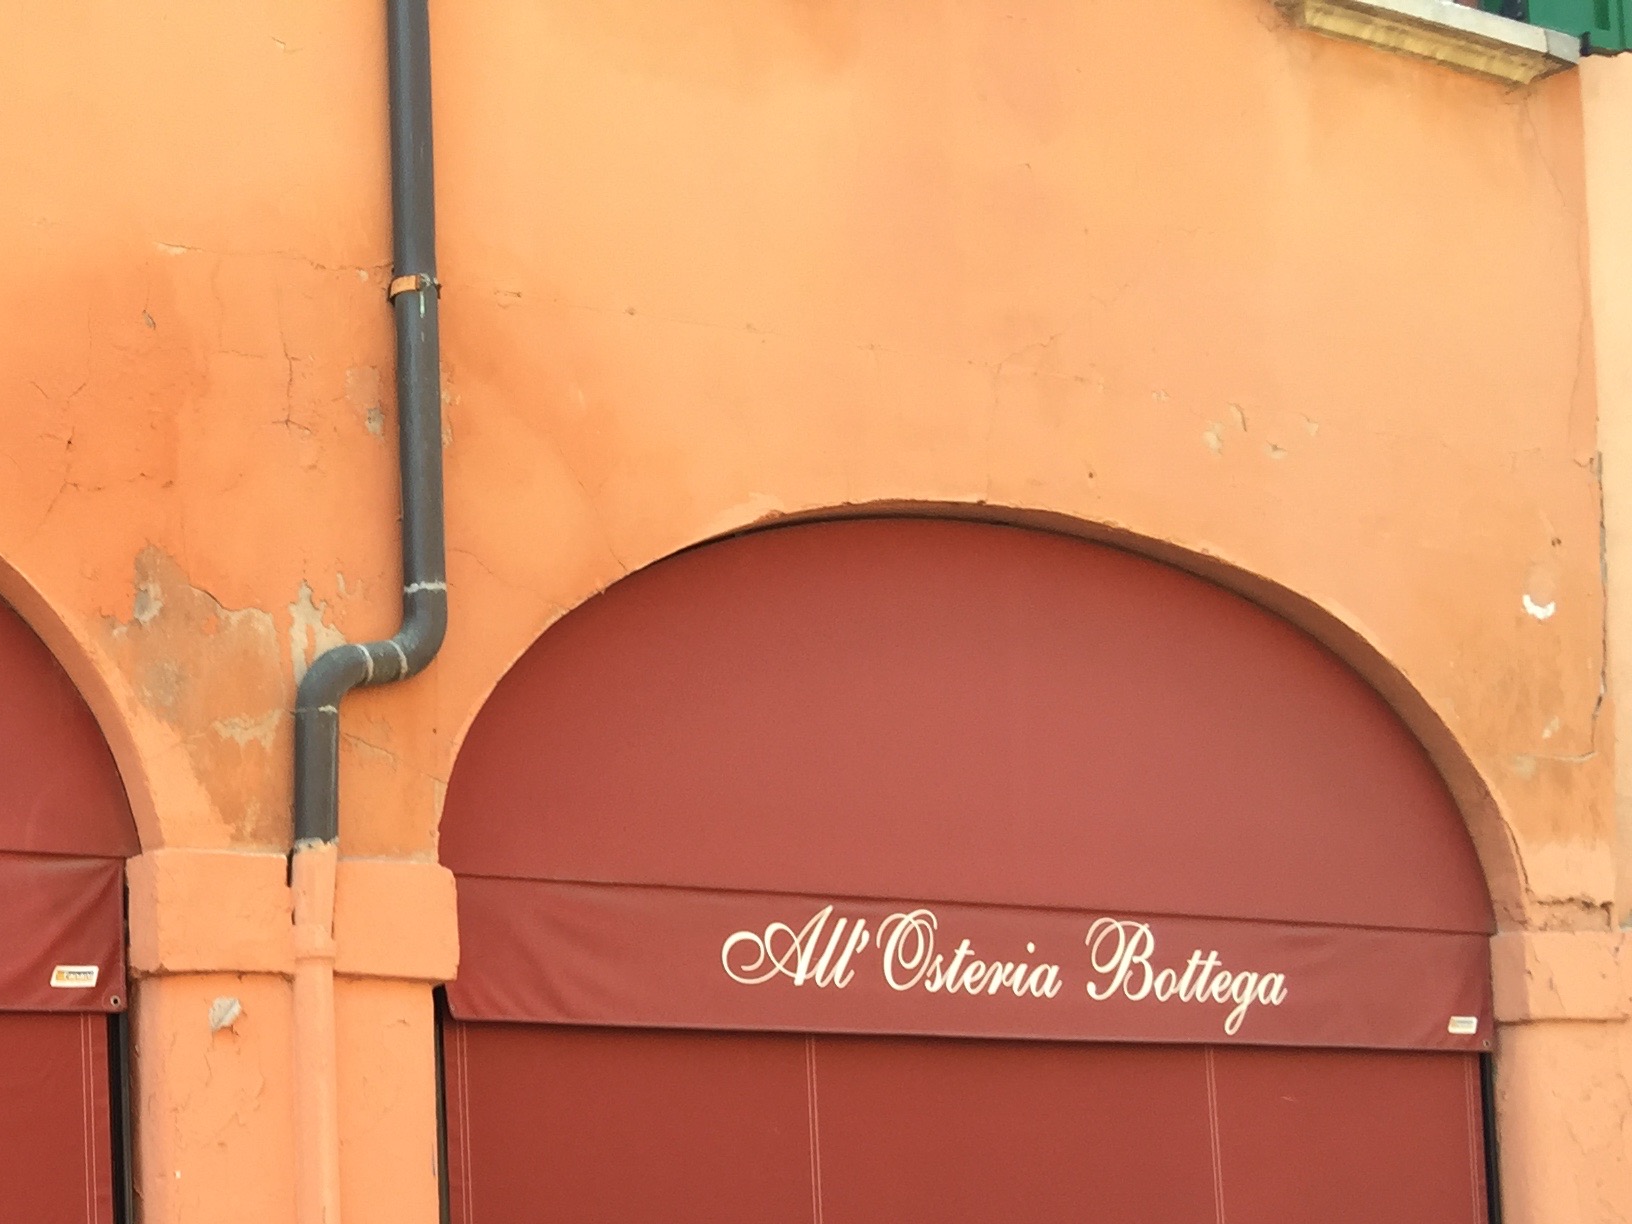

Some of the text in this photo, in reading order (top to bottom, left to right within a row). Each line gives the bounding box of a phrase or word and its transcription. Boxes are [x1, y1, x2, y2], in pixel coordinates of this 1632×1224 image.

[722, 904, 1288, 1035] All' Osteria Bottega
